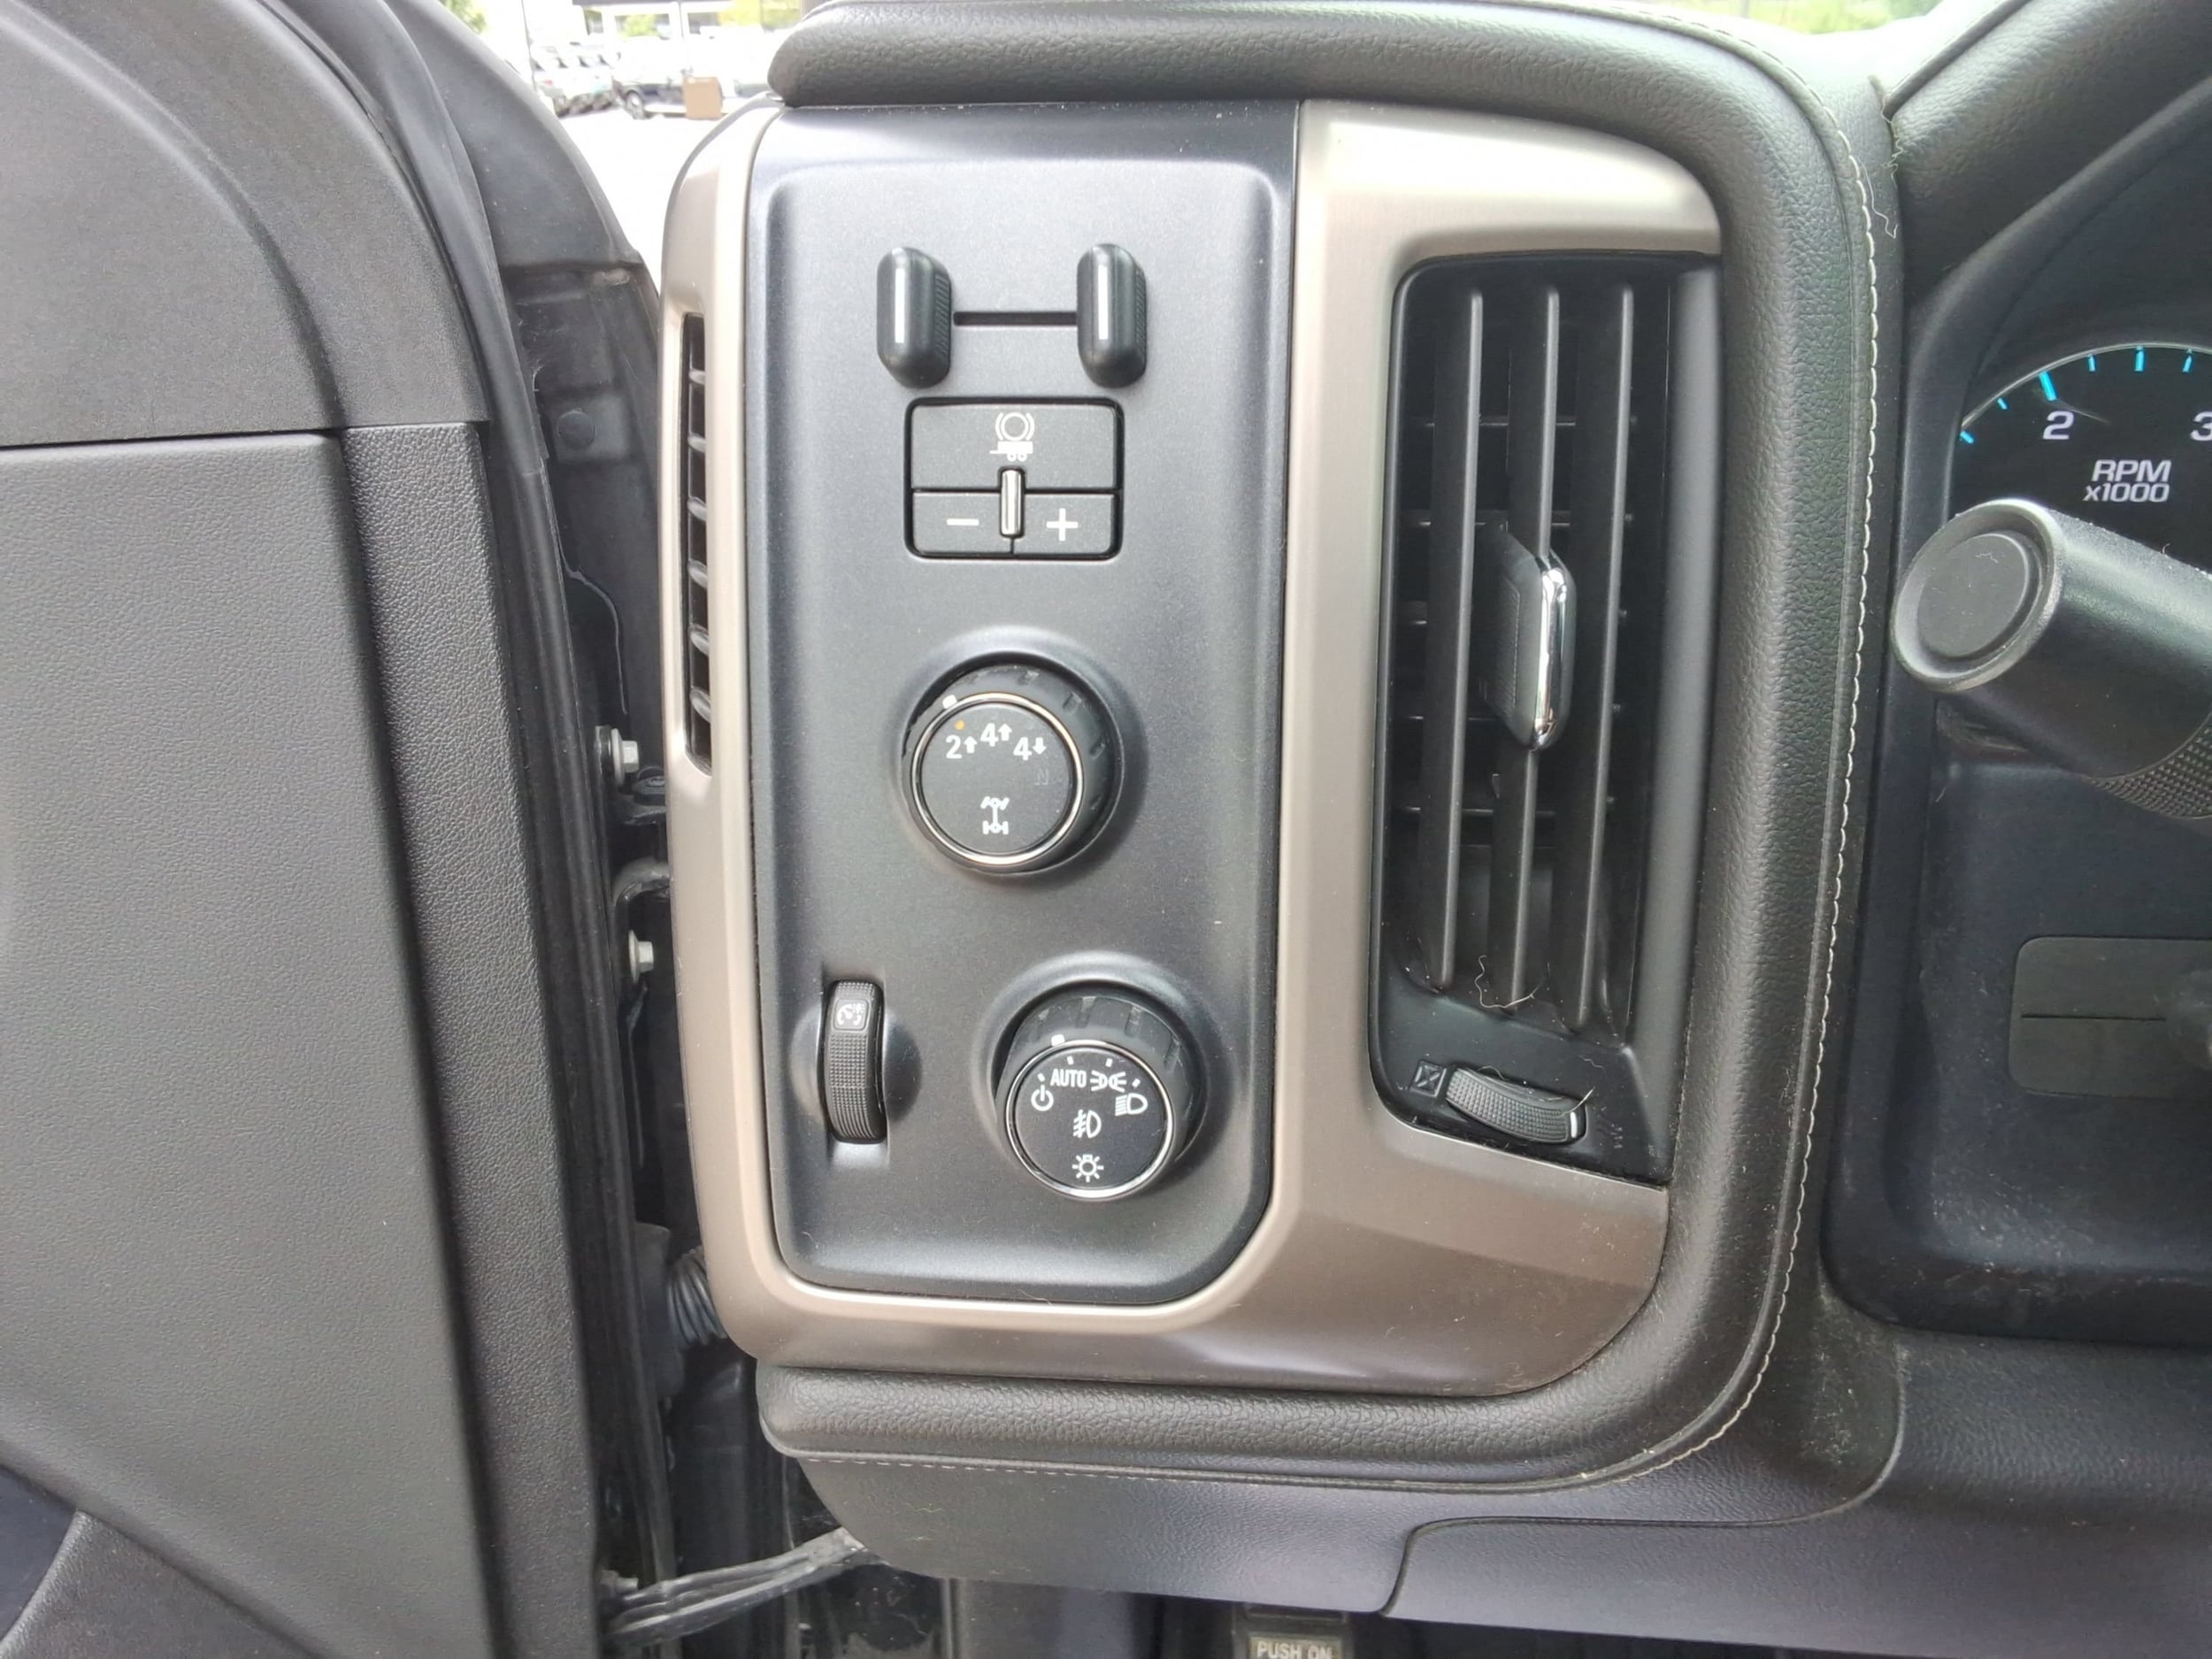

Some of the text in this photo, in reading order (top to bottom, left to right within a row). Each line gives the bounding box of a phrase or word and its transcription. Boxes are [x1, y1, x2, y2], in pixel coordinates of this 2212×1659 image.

[2043, 411, 2075, 440] 2
[2091, 459, 2172, 482] RPM
[1050, 1068, 1087, 1087] AUTO
[1256, 1640, 1302, 1659] PUSH
